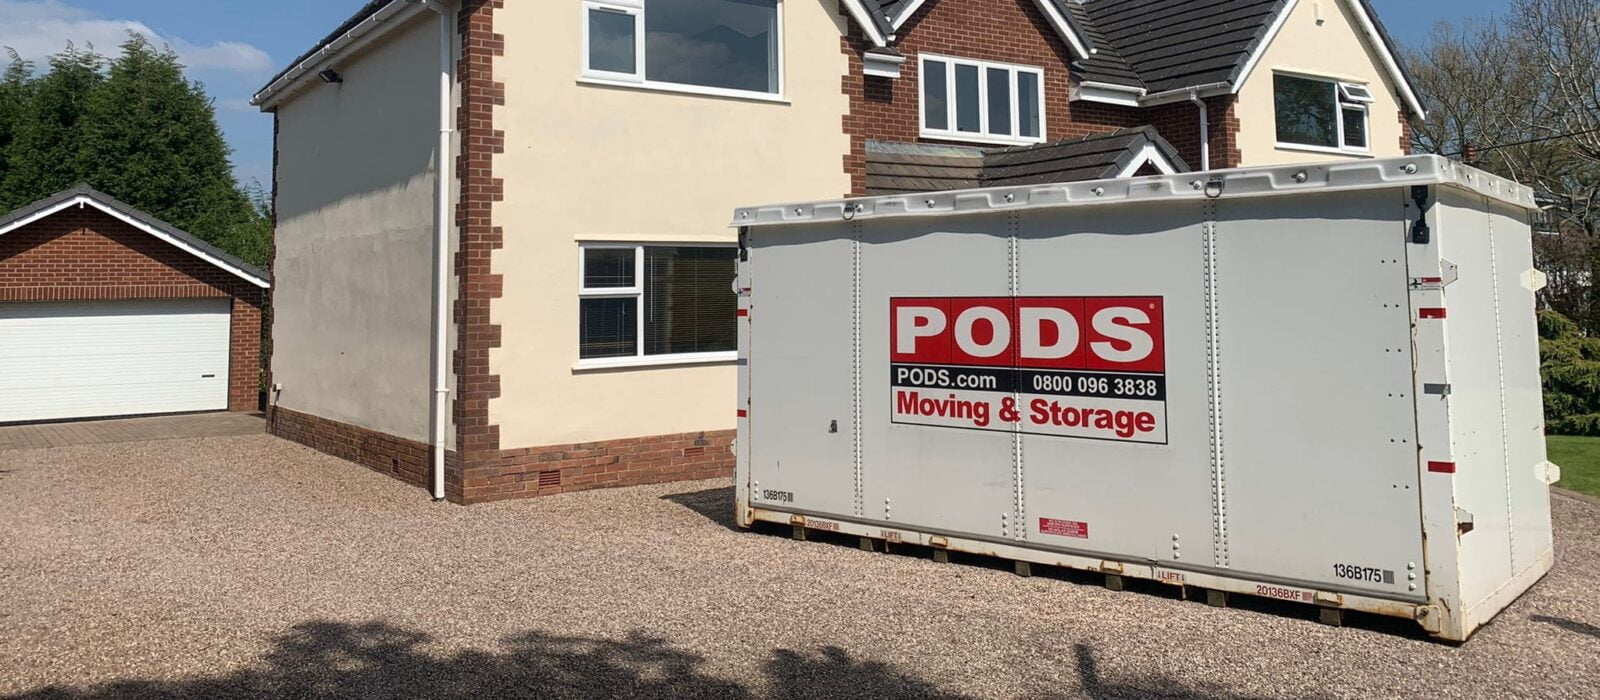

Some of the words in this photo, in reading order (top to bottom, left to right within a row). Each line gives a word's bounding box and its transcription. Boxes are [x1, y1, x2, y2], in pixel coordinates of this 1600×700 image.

[896, 306, 1154, 362] PODS
[897, 367, 997, 389] PODS.com
[1033, 375, 1073, 393] 0800
[1077, 376, 1109, 394] 096
[1114, 379, 1158, 397] 3838
[897, 391, 990, 427] Moving
[999, 396, 1021, 422] &
[1030, 398, 1156, 438] Storage
[762, 489, 787, 502] 136B175
[1333, 563, 1382, 583] 136B175
[1256, 585, 1301, 600] 20136BXF
